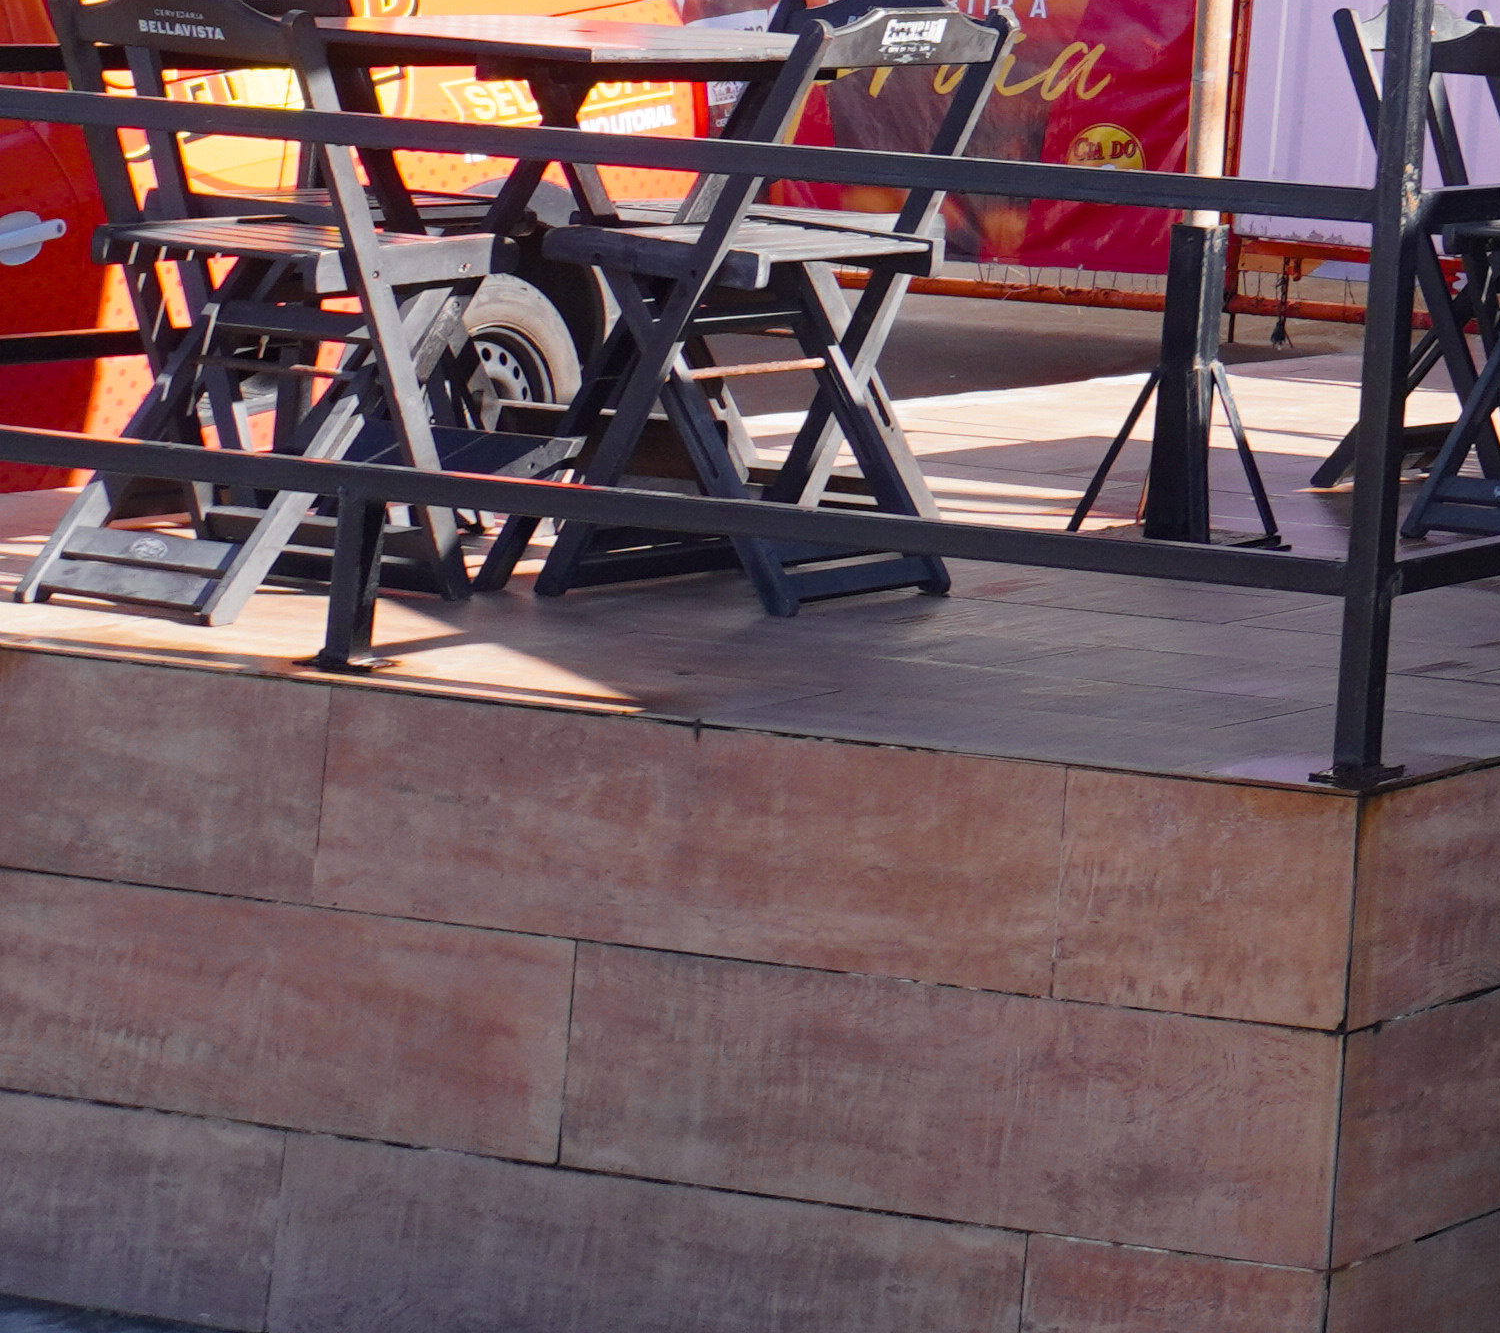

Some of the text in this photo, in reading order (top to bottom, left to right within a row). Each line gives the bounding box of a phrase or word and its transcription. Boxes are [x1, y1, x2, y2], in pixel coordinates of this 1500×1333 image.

[138, 19, 226, 41] BELLAVISTA
[610, 104, 677, 134] LITORAL
[1109, 139, 1138, 160] DO
